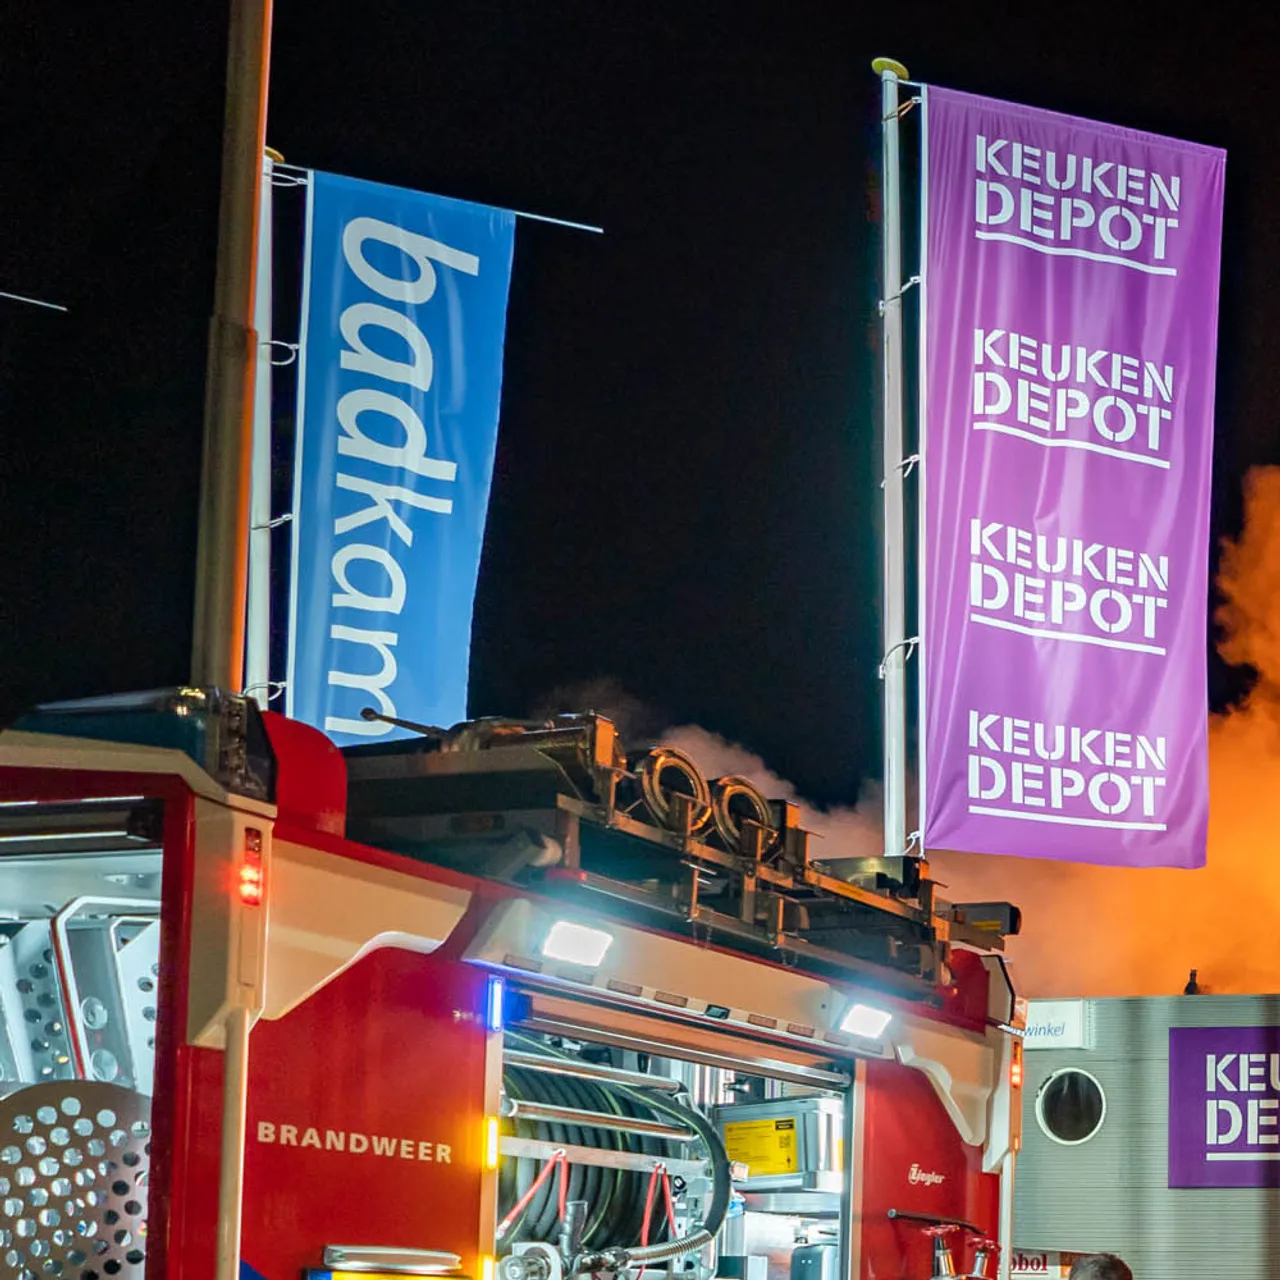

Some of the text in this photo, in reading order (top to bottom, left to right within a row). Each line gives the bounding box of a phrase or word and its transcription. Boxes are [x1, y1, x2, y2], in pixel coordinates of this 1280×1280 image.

[975, 134, 1180, 211] KEUKEN
[975, 179, 1179, 260] DEPOT
[974, 328, 1174, 403] KEUKEN
[973, 371, 1172, 451] DEPOT
[970, 518, 1169, 592] KEUKEN
[970, 563, 1168, 639] DEPOT
[968, 710, 1166, 771] KEUKEN
[968, 754, 1166, 817] DEPOT
[1013, 1022, 1065, 1037] winkel
[257, 1121, 452, 1164] BRANDWEER
